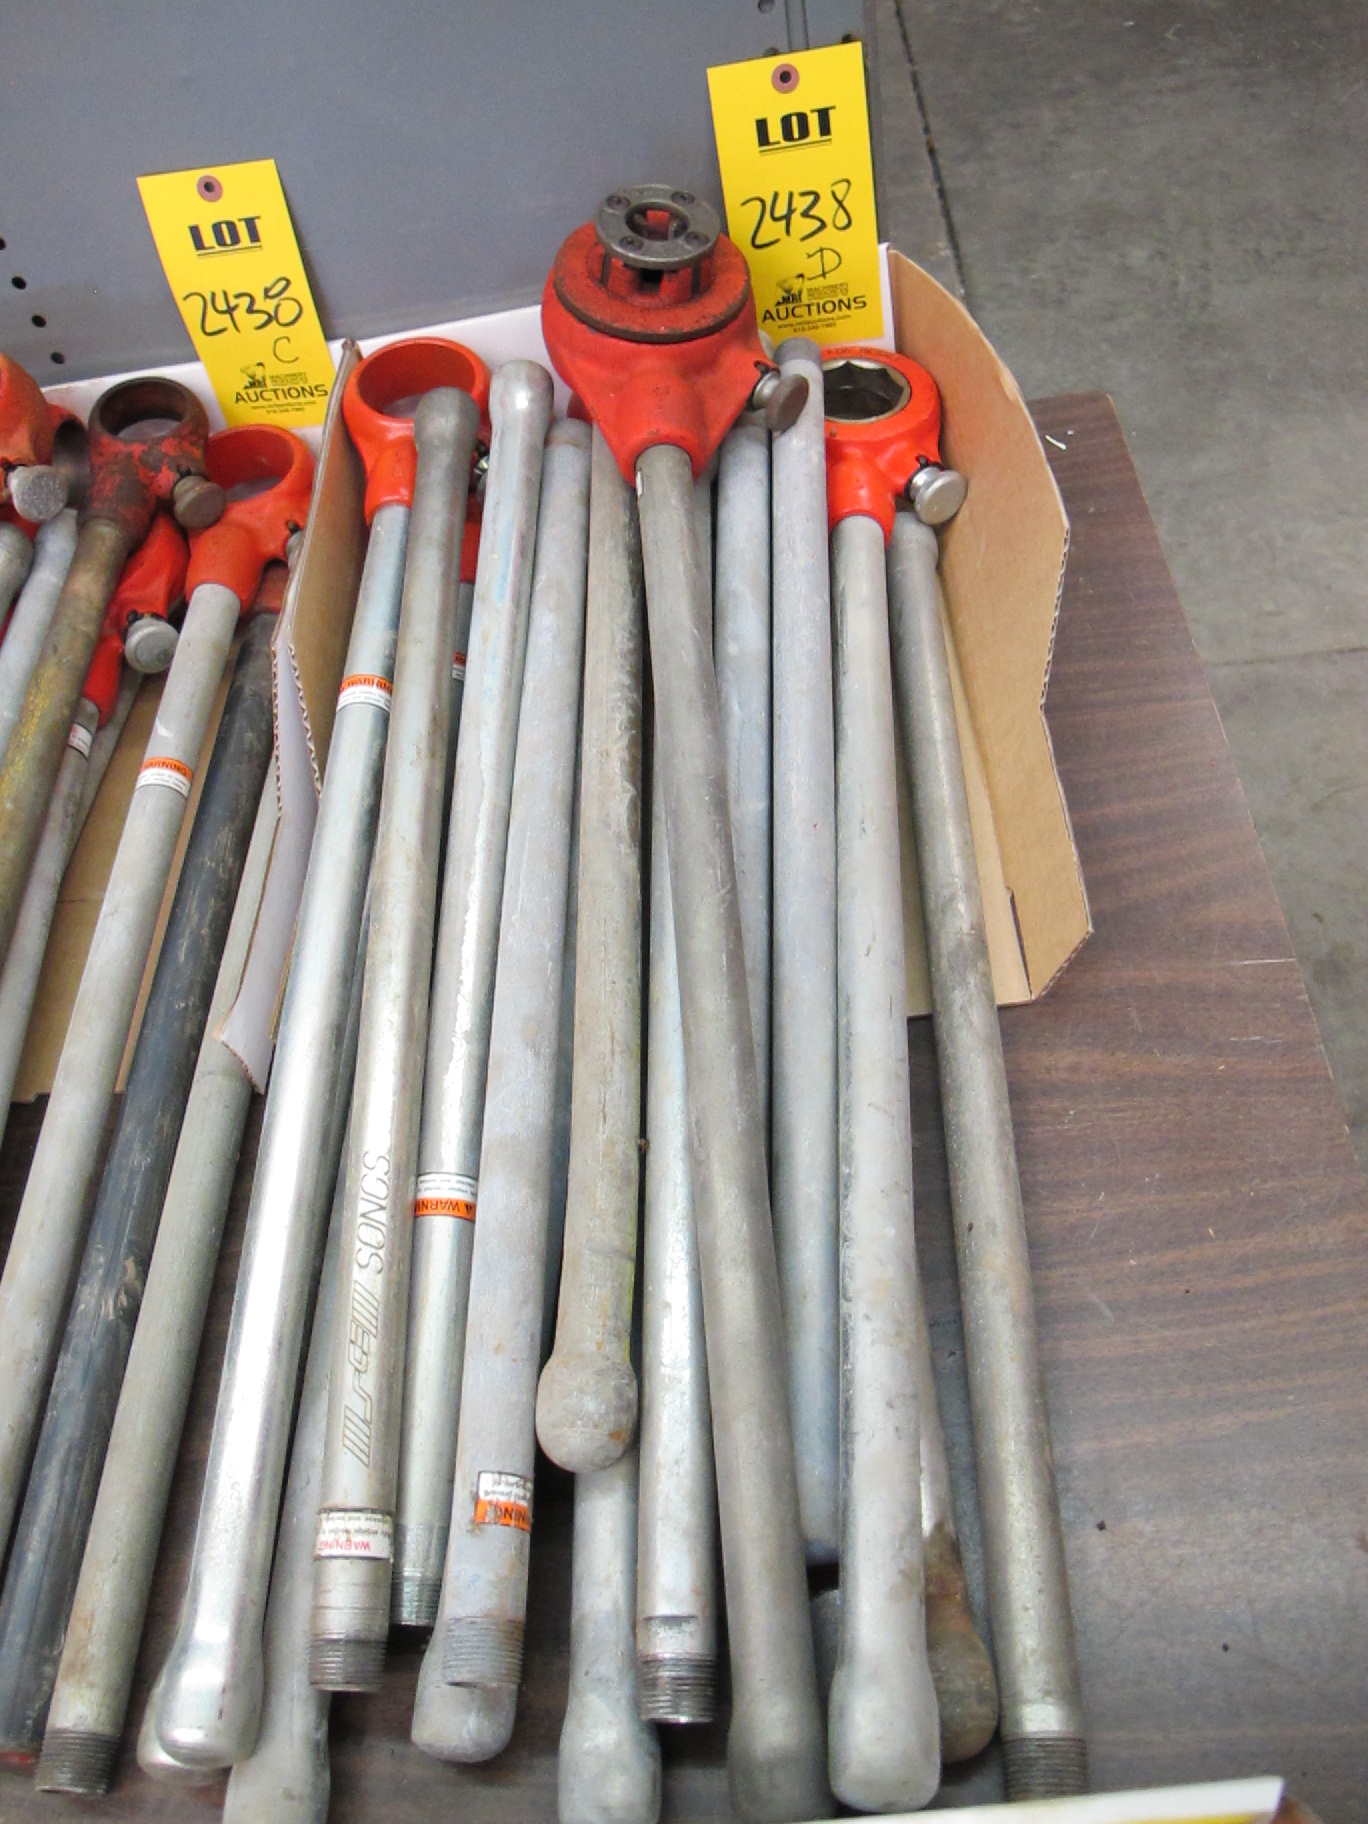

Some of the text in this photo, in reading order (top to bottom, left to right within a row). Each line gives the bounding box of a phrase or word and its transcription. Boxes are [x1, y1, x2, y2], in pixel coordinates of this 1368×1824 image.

[755, 105, 836, 147] LOT
[741, 178, 852, 250] 2438
[188, 216, 262, 252] LOT
[806, 247, 842, 280] D
[183, 276, 303, 337] 2438
[762, 295, 867, 323] AUCTIONS
[272, 336, 299, 363] C
[235, 384, 329, 404] AUCTIONS
[356, 1150, 391, 1275] SONGS
